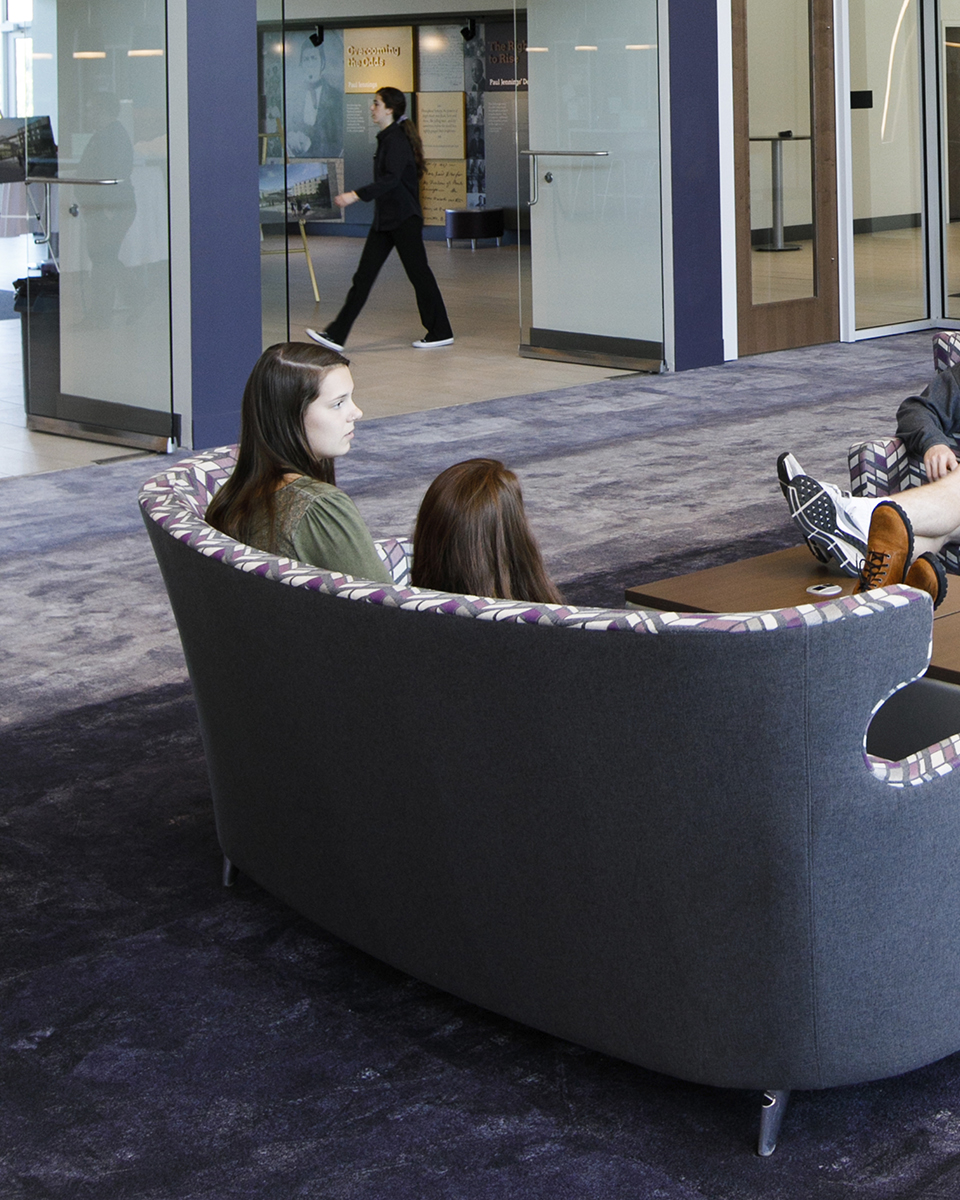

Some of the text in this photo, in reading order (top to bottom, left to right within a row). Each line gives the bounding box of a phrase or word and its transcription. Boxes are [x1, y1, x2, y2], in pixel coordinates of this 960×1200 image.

[347, 44, 401, 57] Overcoming
[347, 56, 386, 68] the Odds
[489, 78, 500, 86] Paul
